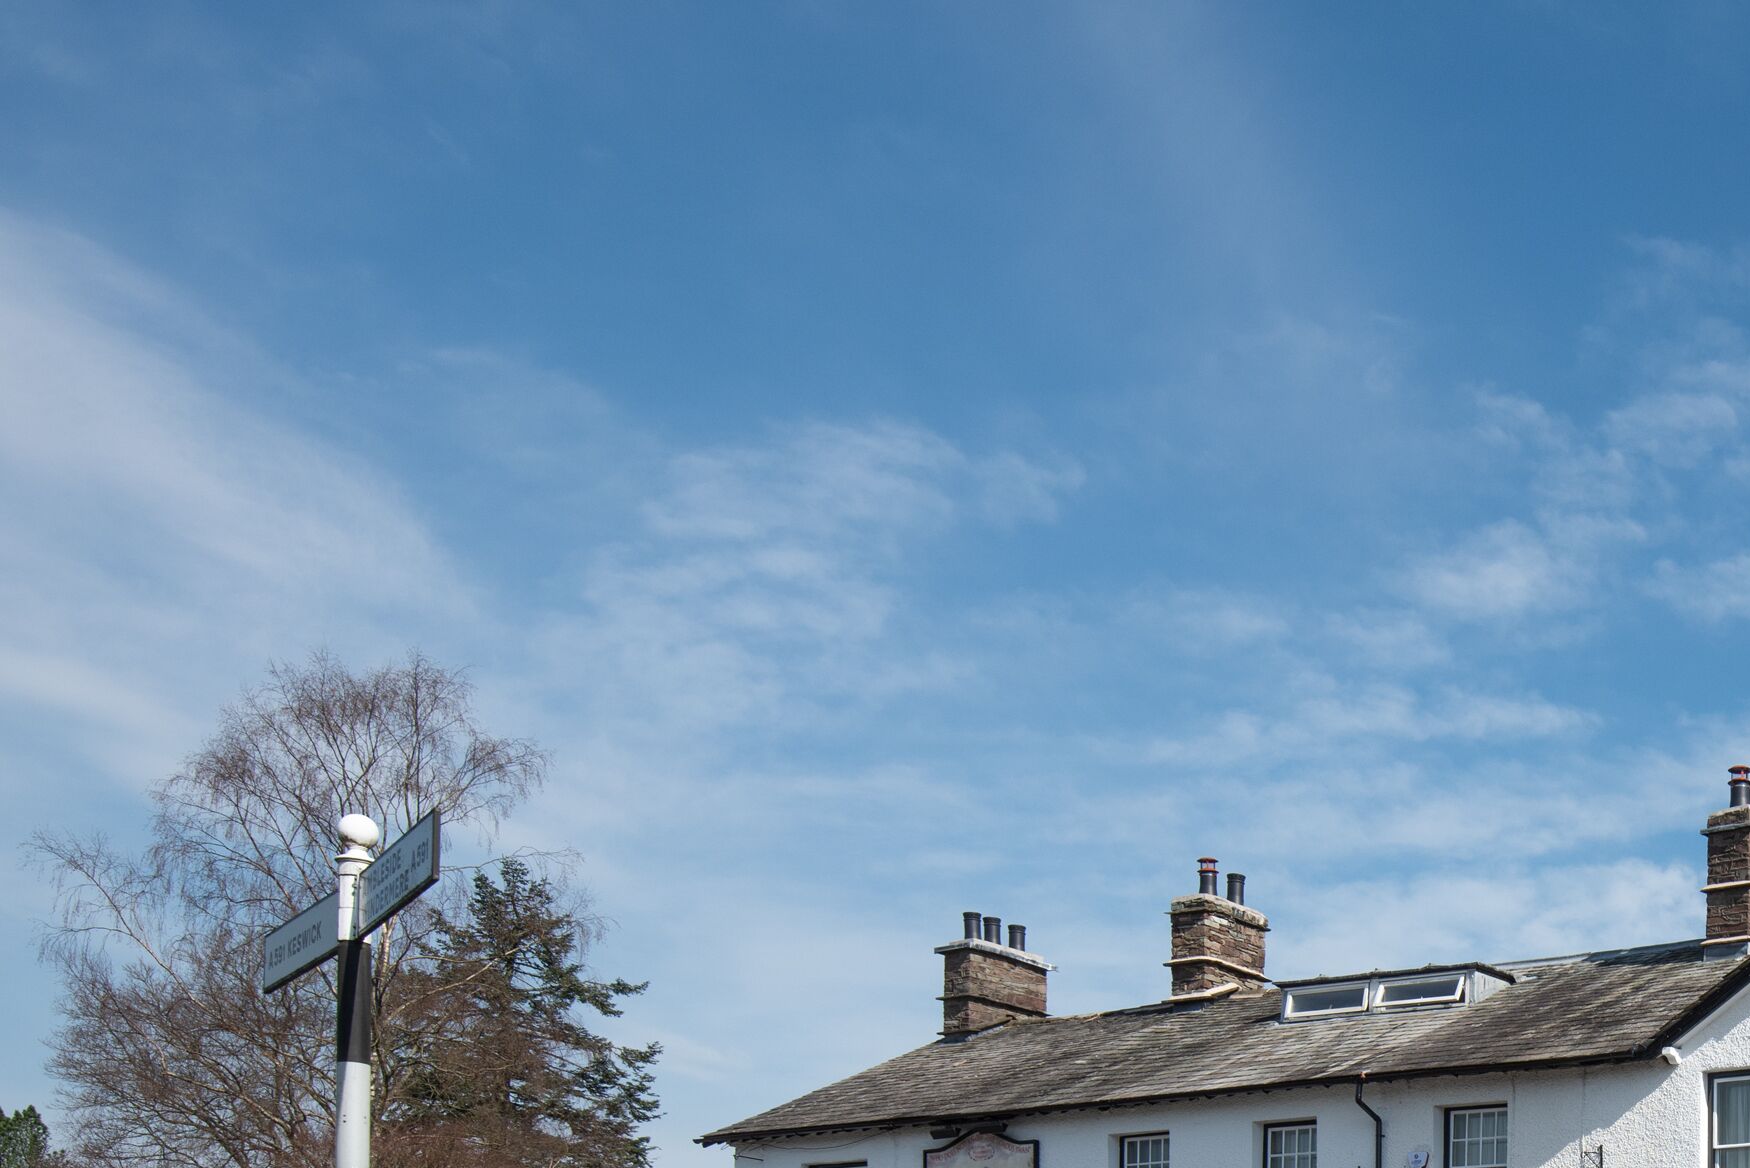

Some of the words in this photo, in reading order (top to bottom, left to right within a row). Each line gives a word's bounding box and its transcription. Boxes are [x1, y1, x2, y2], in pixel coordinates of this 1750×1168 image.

[362, 847, 401, 895] MBLESIDE
[411, 838, 429, 872] A591
[364, 868, 408, 920] INDERMERE
[268, 943, 286, 970] A591
[288, 919, 322, 959] KESWICK
